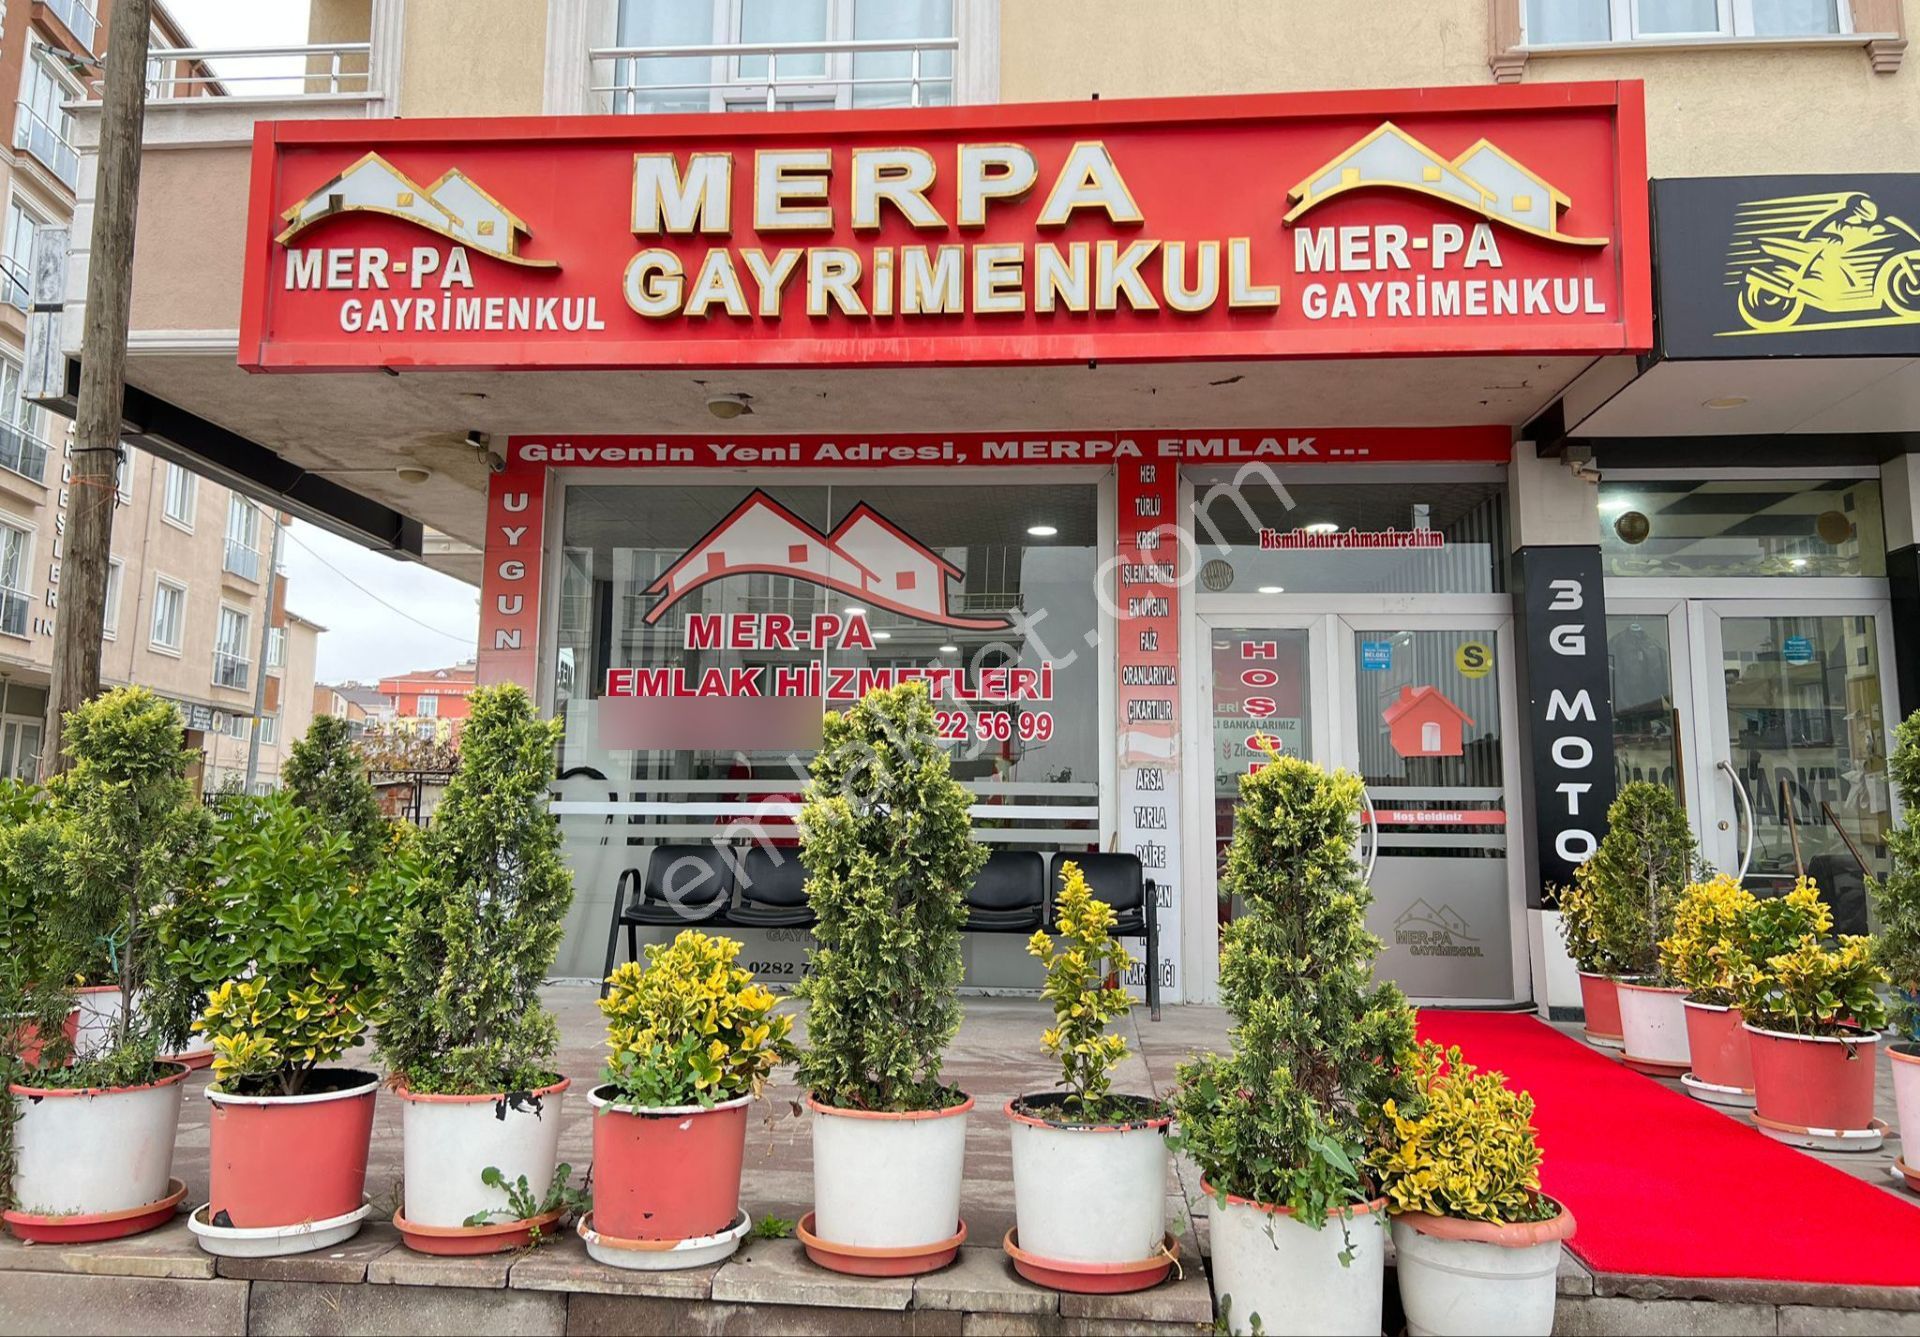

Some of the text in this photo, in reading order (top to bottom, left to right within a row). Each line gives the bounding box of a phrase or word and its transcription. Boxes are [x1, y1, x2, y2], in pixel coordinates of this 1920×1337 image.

[630, 140, 1145, 237] MERPA
[1294, 222, 1503, 274] MER-PA
[285, 246, 474, 290] MER-PA
[623, 237, 1282, 320] GAYRİMENKUL
[1302, 273, 1607, 320] GAYRİMENKUL
[340, 291, 605, 333] GAYRİMENKUL
[518, 443, 694, 462] Güvenin
[706, 443, 800, 461] Yeni
[813, 441, 967, 463] Adresi,
[981, 440, 1143, 459] MERPA
[1157, 437, 1318, 457] EMLAK
[1140, 465, 1155, 483] HER
[1135, 495, 1161, 516] TÜRLÜ
[1136, 531, 1160, 550] KREDİ
[1259, 527, 1445, 550] Bismillahirrahmanirrahim
[494, 493, 529, 650] UYGUN
[1129, 599, 1168, 617] EN UYGUN
[684, 612, 877, 651] MER-PA
[1140, 627, 1158, 651] FAİZ
[1463, 645, 1484, 668] S
[606, 667, 765, 697] EMLAK
[1122, 666, 1177, 685] ORANLARIYLA
[1127, 699, 1173, 724] ÇIKARTILIR
[1545, 579, 1598, 862] 3G MOTO
[975, 711, 1011, 741] 56
[1018, 711, 1054, 741] 99
[1222, 720, 1296, 731] BANKALARIMIZ
[1136, 768, 1164, 790] ARSA
[1134, 806, 1167, 829] TARLA
[1393, 812, 1463, 823] Hoş Geldiniz
[1395, 931, 1453, 945] MER-PA
[749, 961, 794, 975] 0282
